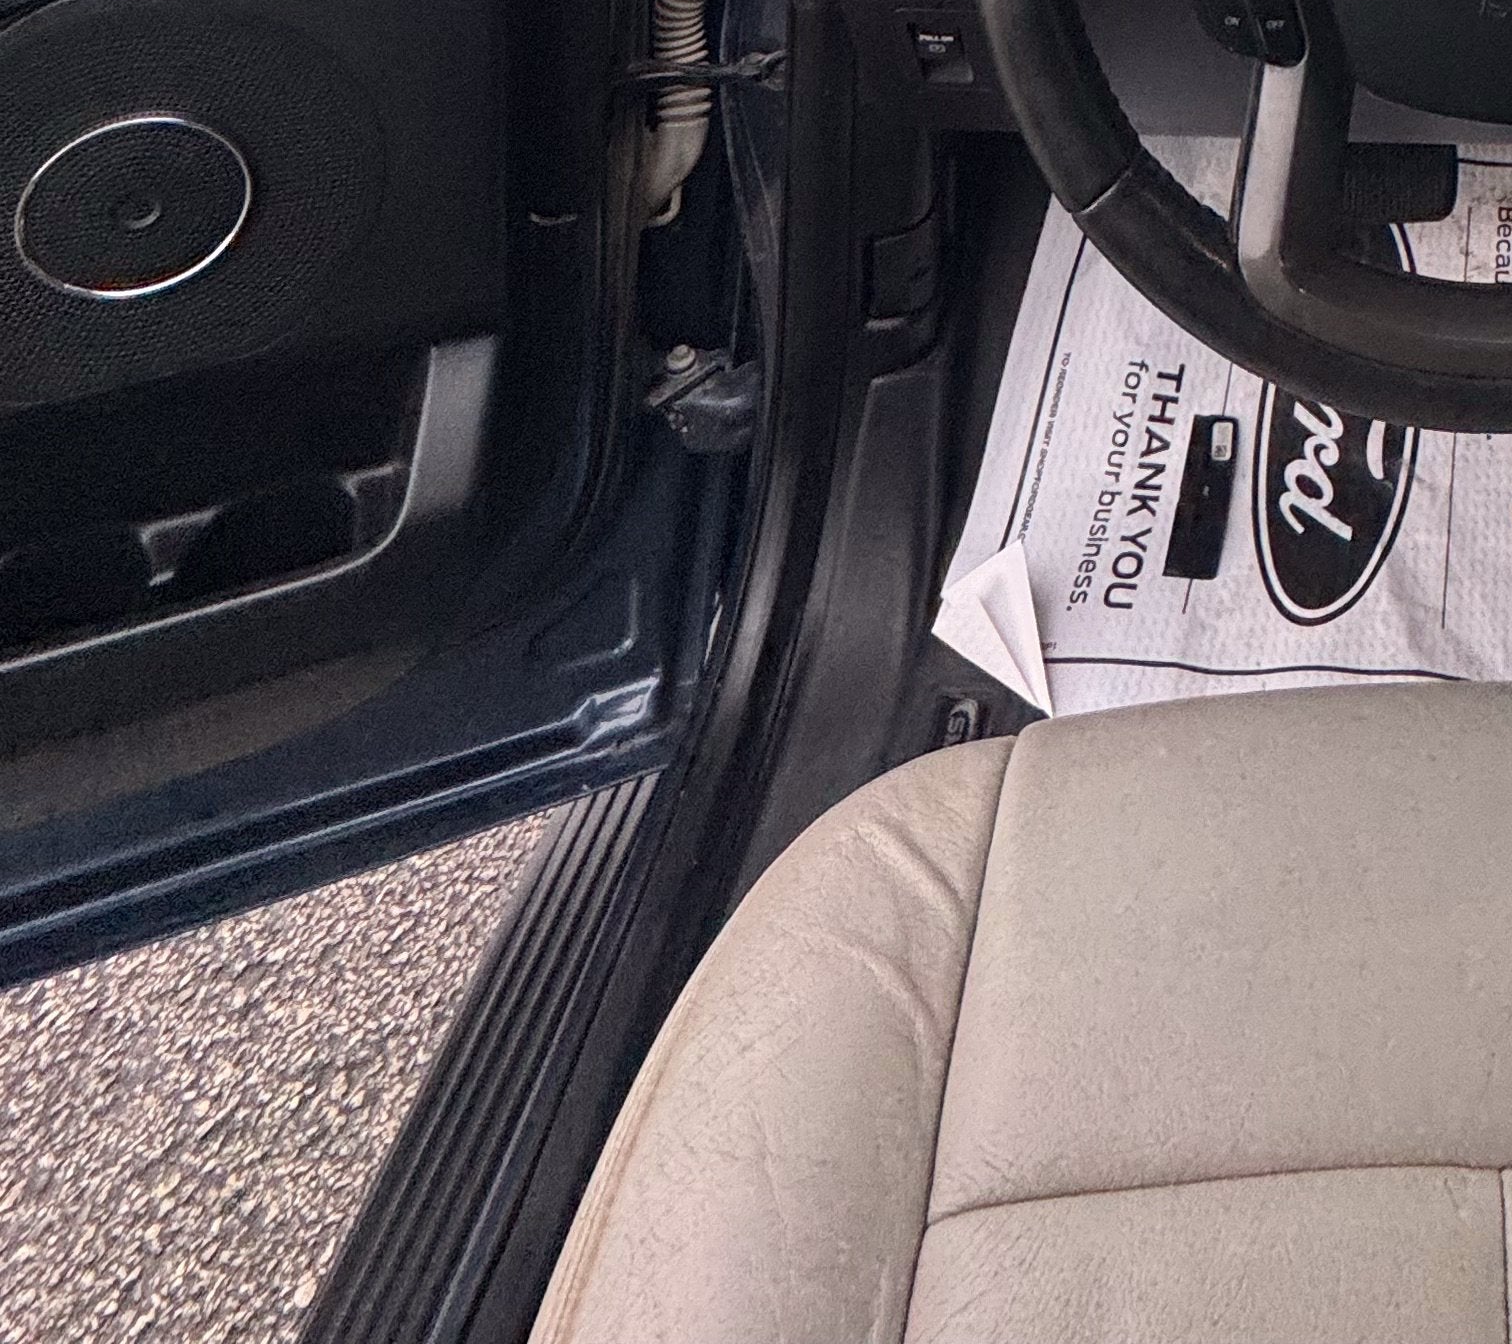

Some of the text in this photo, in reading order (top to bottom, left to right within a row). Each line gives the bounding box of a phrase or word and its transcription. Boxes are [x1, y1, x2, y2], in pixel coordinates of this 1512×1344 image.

[1224, 15, 1240, 27] ON
[1265, 19, 1285, 30] OFF
[1061, 351, 1072, 367] TO
[1066, 359, 1150, 612] for your business.
[1103, 363, 1186, 610] THANK YOU
